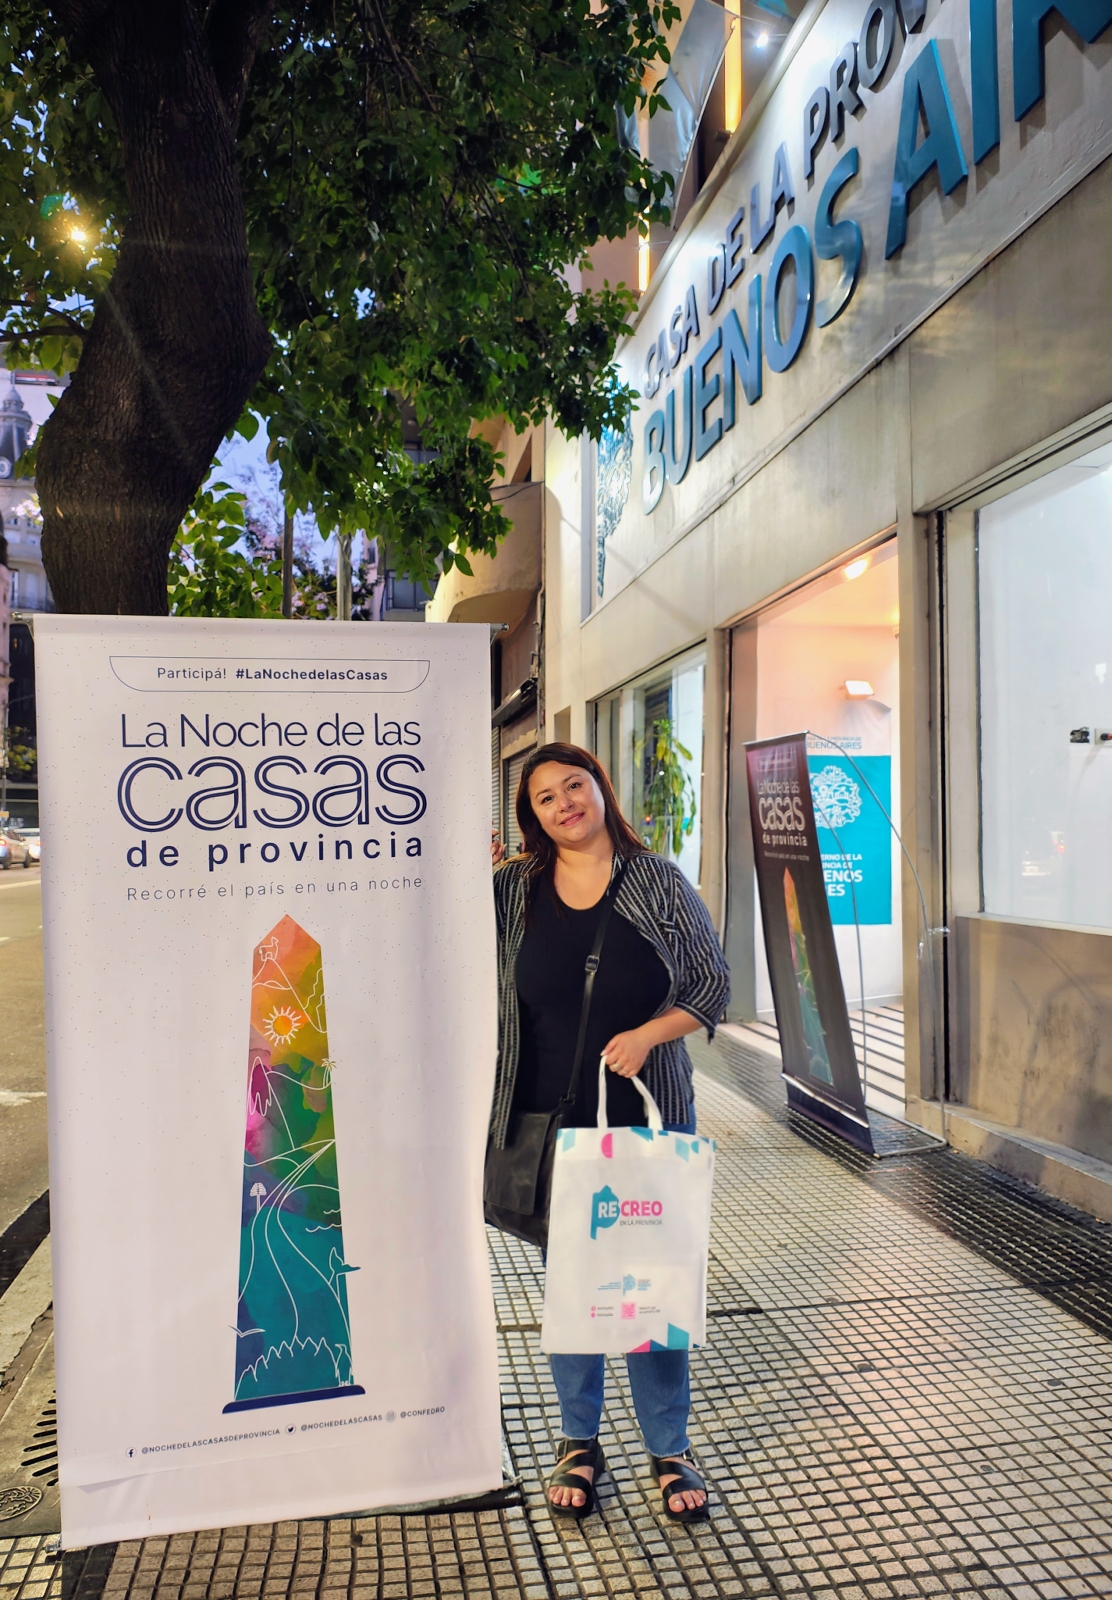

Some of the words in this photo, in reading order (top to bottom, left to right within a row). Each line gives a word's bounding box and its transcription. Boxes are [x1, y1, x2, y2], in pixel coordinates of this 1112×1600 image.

[643, 285, 700, 400] CASA
[708, 206, 745, 316] DE
[751, 142, 795, 254] LA
[643, 147, 863, 516] BUENOS
[157, 667, 227, 681] Participá!
[236, 668, 388, 681] #LaNochedelasCasas
[122, 713, 168, 747] La
[181, 713, 307, 747] Noche
[317, 713, 364, 746] de
[375, 713, 421, 745] las
[117, 754, 427, 832] casas
[127, 839, 179, 867] de
[208, 831, 422, 872] provincia
[772, 832, 808, 848] provincia
[127, 884, 206, 901] Recorré
[217, 884, 234, 898] el
[245, 882, 285, 899] país
[295, 883, 316, 894] en
[326, 881, 358, 893] una
[368, 876, 423, 890] noche
[823, 869, 863, 883] ENOS
[598, 1200, 663, 1218] RECREO
[141, 1429, 281, 1455] @NOCHEDELASCASASDEPROVINCIA
[300, 1414, 383, 1432] @NOCHEDELASCASAS
[400, 1405, 446, 1419] @CONFEDRO
